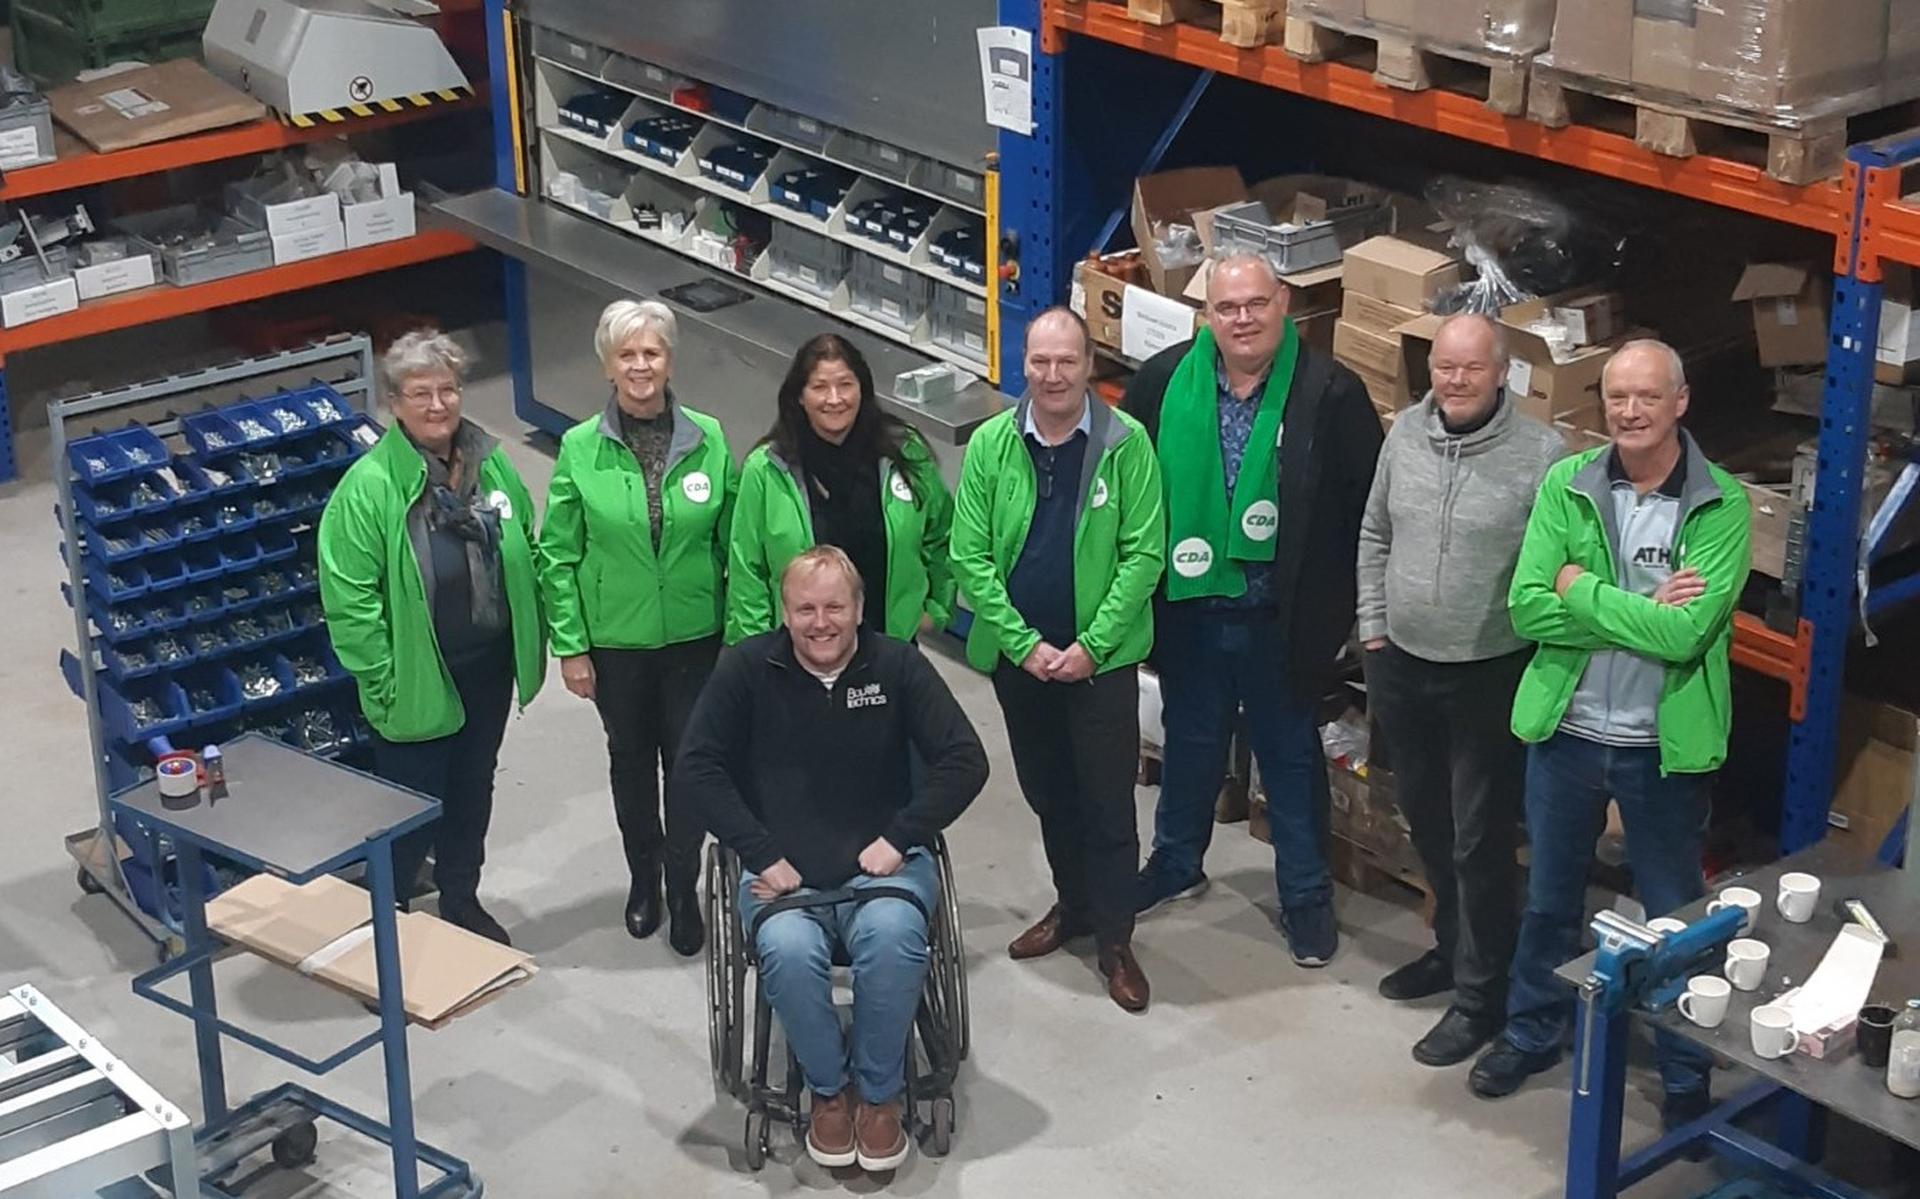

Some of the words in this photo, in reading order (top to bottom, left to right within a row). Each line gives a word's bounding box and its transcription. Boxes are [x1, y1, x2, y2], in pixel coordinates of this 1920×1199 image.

[686, 482, 709, 492] CDA
[1247, 514, 1276, 527] CDA
[1176, 551, 1210, 563] CDA
